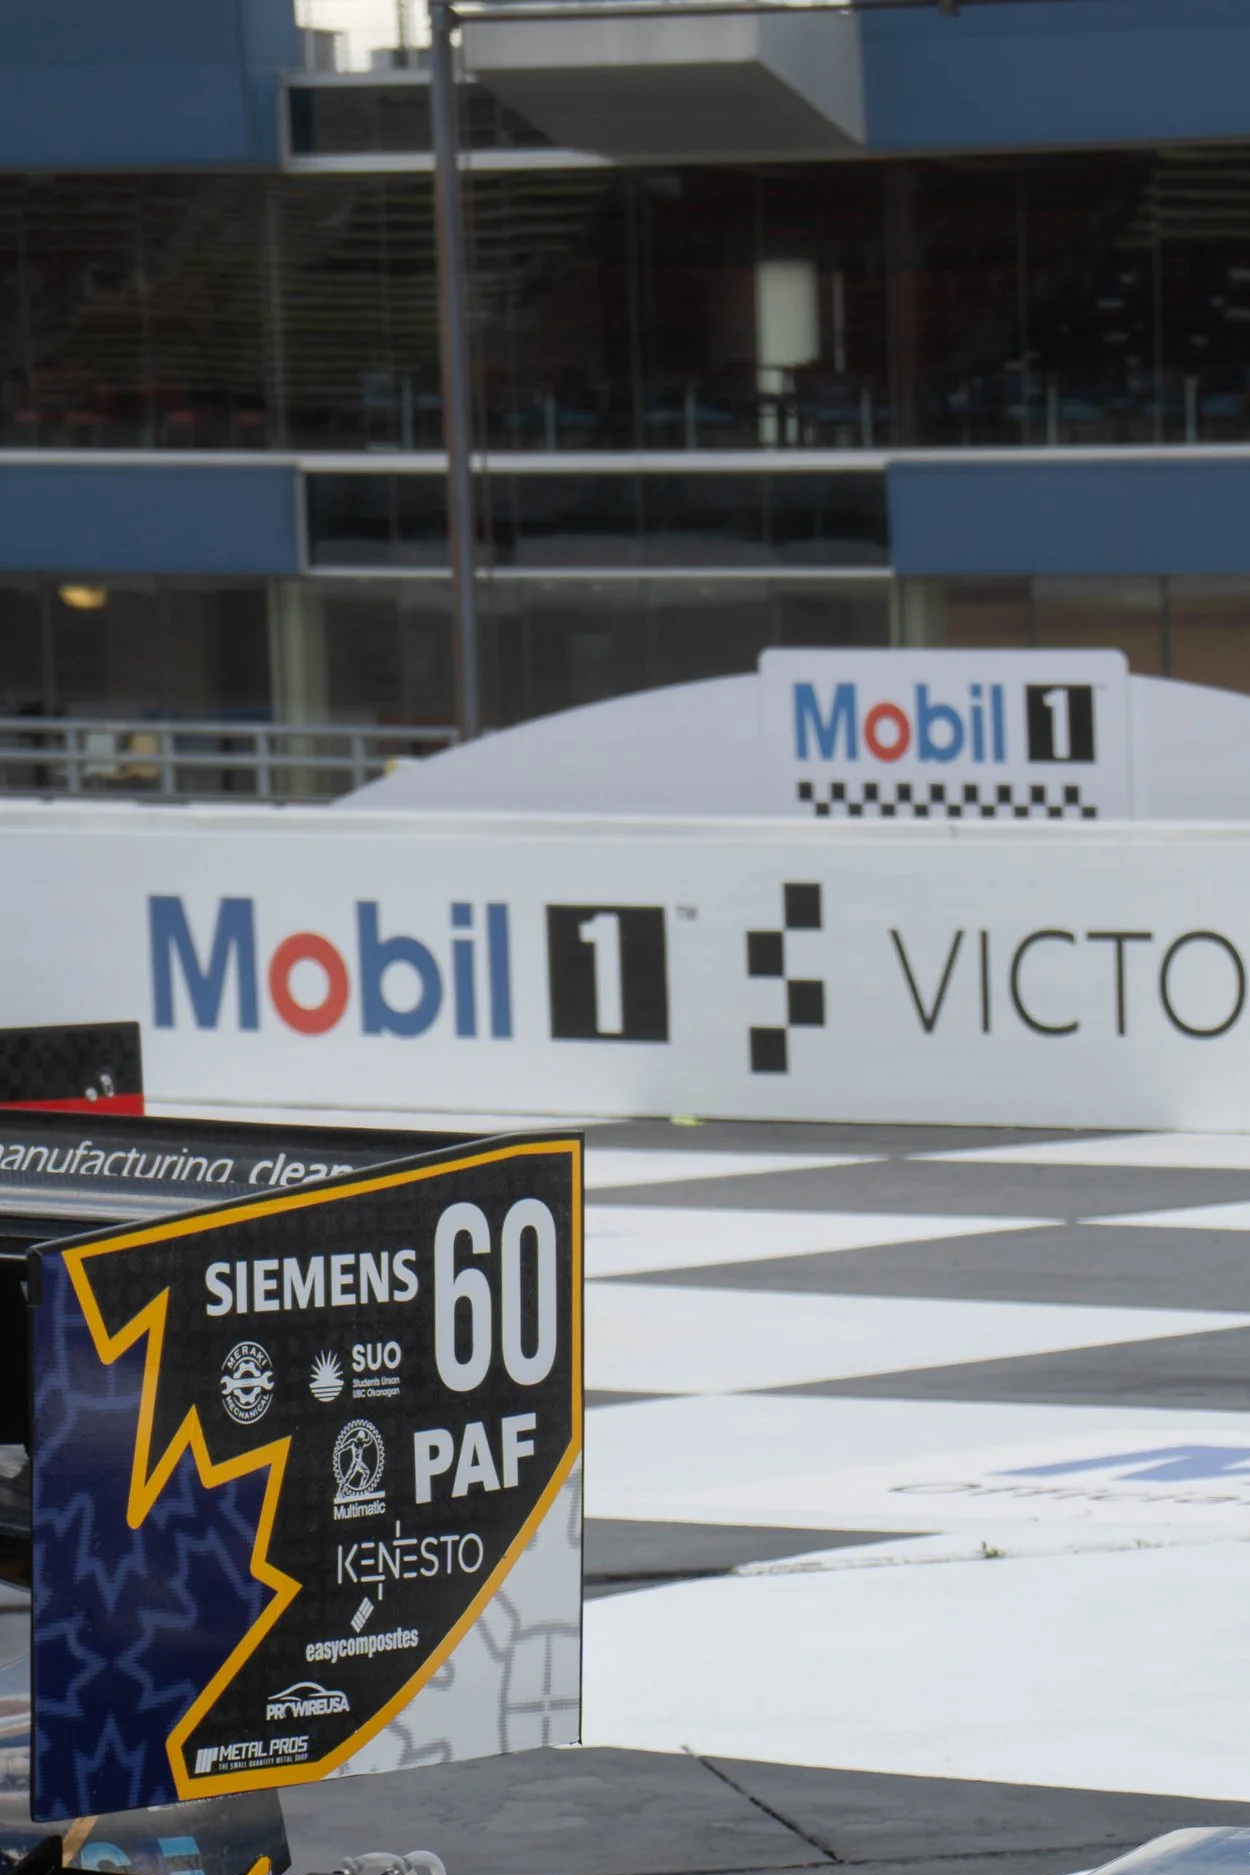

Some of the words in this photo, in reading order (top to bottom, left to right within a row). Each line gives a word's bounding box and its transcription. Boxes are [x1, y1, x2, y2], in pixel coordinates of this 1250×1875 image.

[793, 682, 1006, 764] Mobil
[147, 895, 514, 1038] Mobil
[205, 1249, 420, 1317] SIEMENS
[433, 1197, 558, 1393] 60
[225, 1344, 269, 1370] MERAKI
[351, 1340, 403, 1373] SUO
[224, 1393, 270, 1421] MECHANICAL
[413, 1412, 537, 1505] PAF
[333, 1500, 386, 1521] Multimatic
[337, 1531, 484, 1587] KENESTO
[305, 1627, 419, 1664] easycomposites
[219, 1741, 268, 1762] METAL
[269, 1734, 310, 1756] PROS
